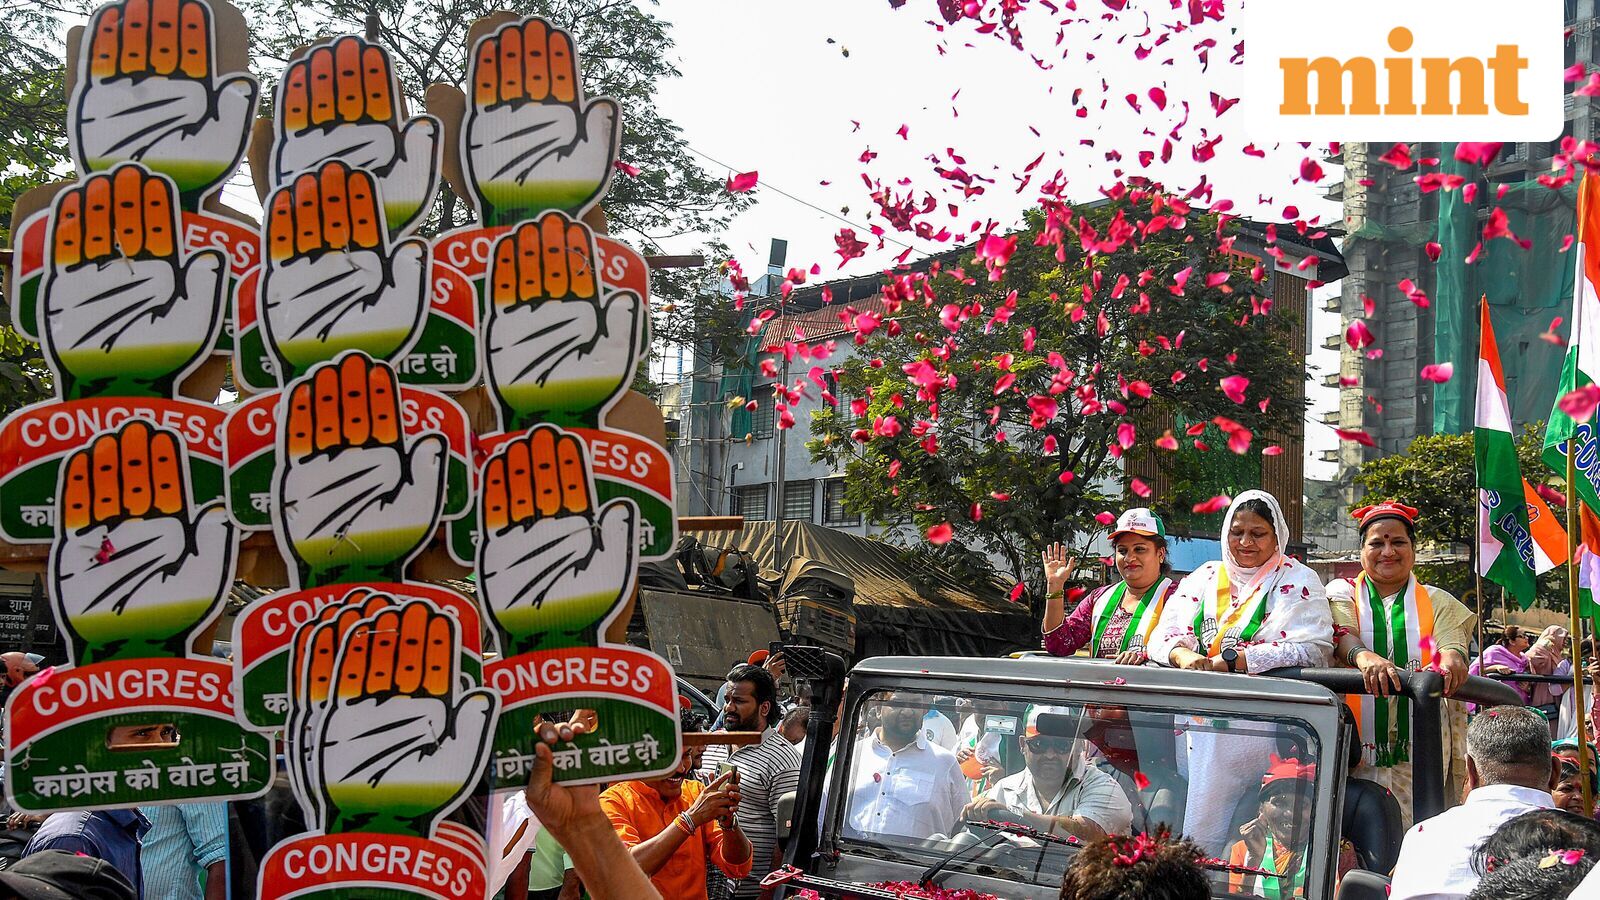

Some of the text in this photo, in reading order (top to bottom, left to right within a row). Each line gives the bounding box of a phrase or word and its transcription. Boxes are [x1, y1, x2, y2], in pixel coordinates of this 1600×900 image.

[490, 658, 654, 697] ONGRESS
[588, 739, 631, 766] वोट
[32, 753, 250, 798] कांग्रेस को वोट दो
[283, 842, 472, 897] CONGRESS
